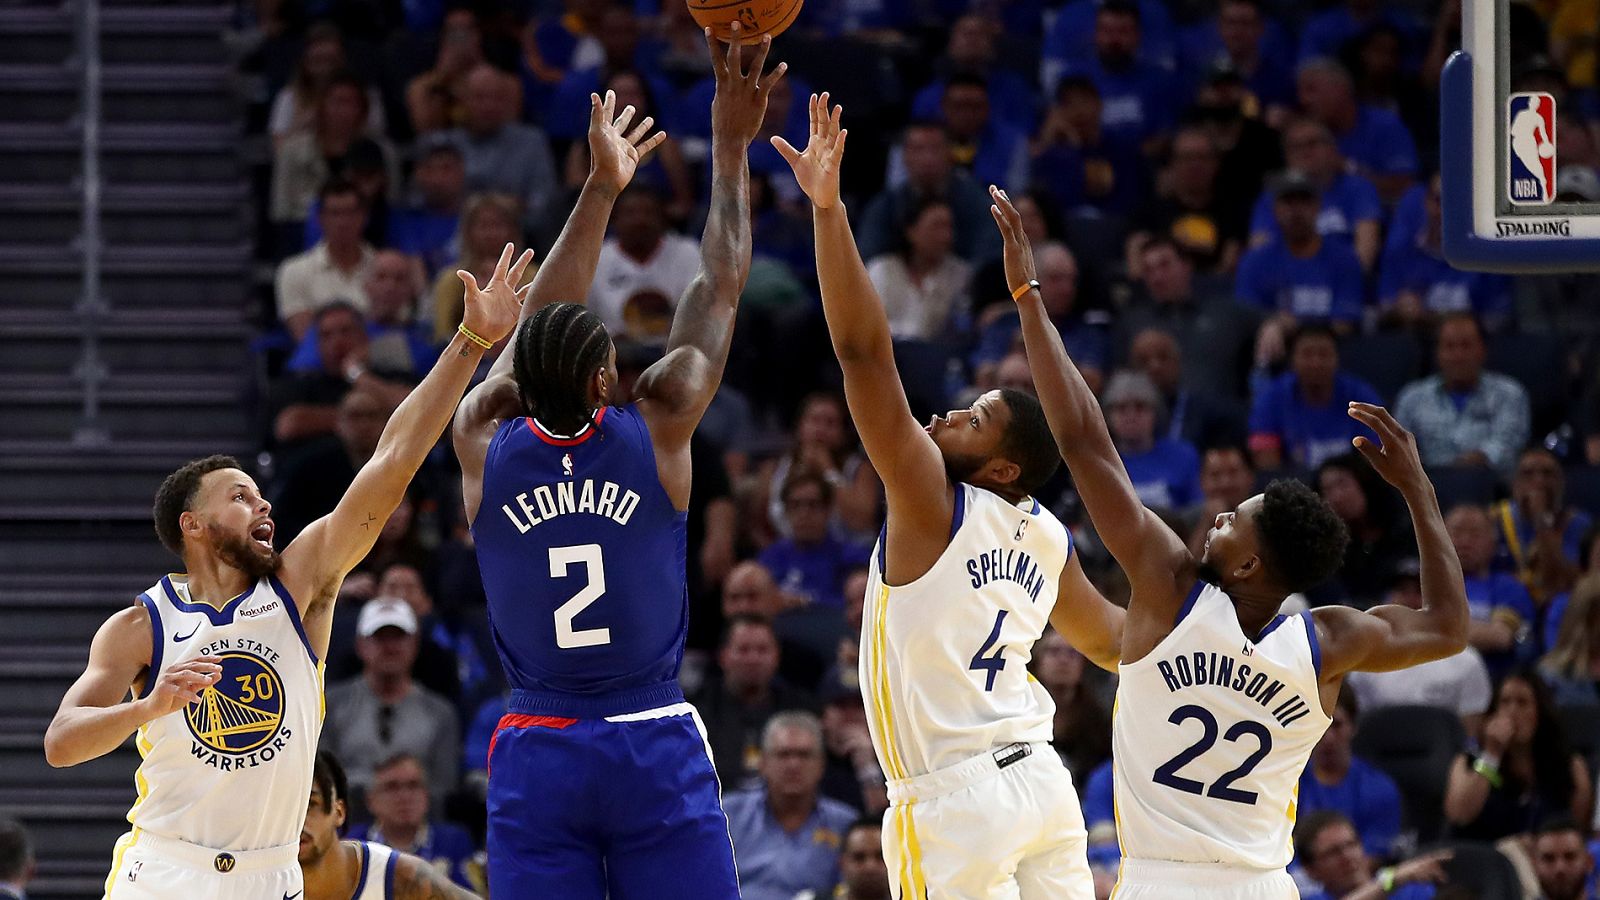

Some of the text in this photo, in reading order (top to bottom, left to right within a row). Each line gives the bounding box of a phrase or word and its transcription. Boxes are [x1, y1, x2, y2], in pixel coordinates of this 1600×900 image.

[1515, 179, 1538, 198] NBA
[1496, 219, 1570, 238] SPALDING
[502, 479, 641, 535] LEONARD
[548, 543, 611, 649] 2
[966, 548, 1045, 604] SPELLMAN
[239, 601, 279, 618] Rakuten
[200, 638, 280, 664] DEN STATE
[969, 609, 1009, 692] 4
[235, 672, 274, 703] 30
[1157, 651, 1311, 729] ROBINSON III
[190, 726, 292, 772] WARRIORS
[1152, 704, 1273, 806] 22
